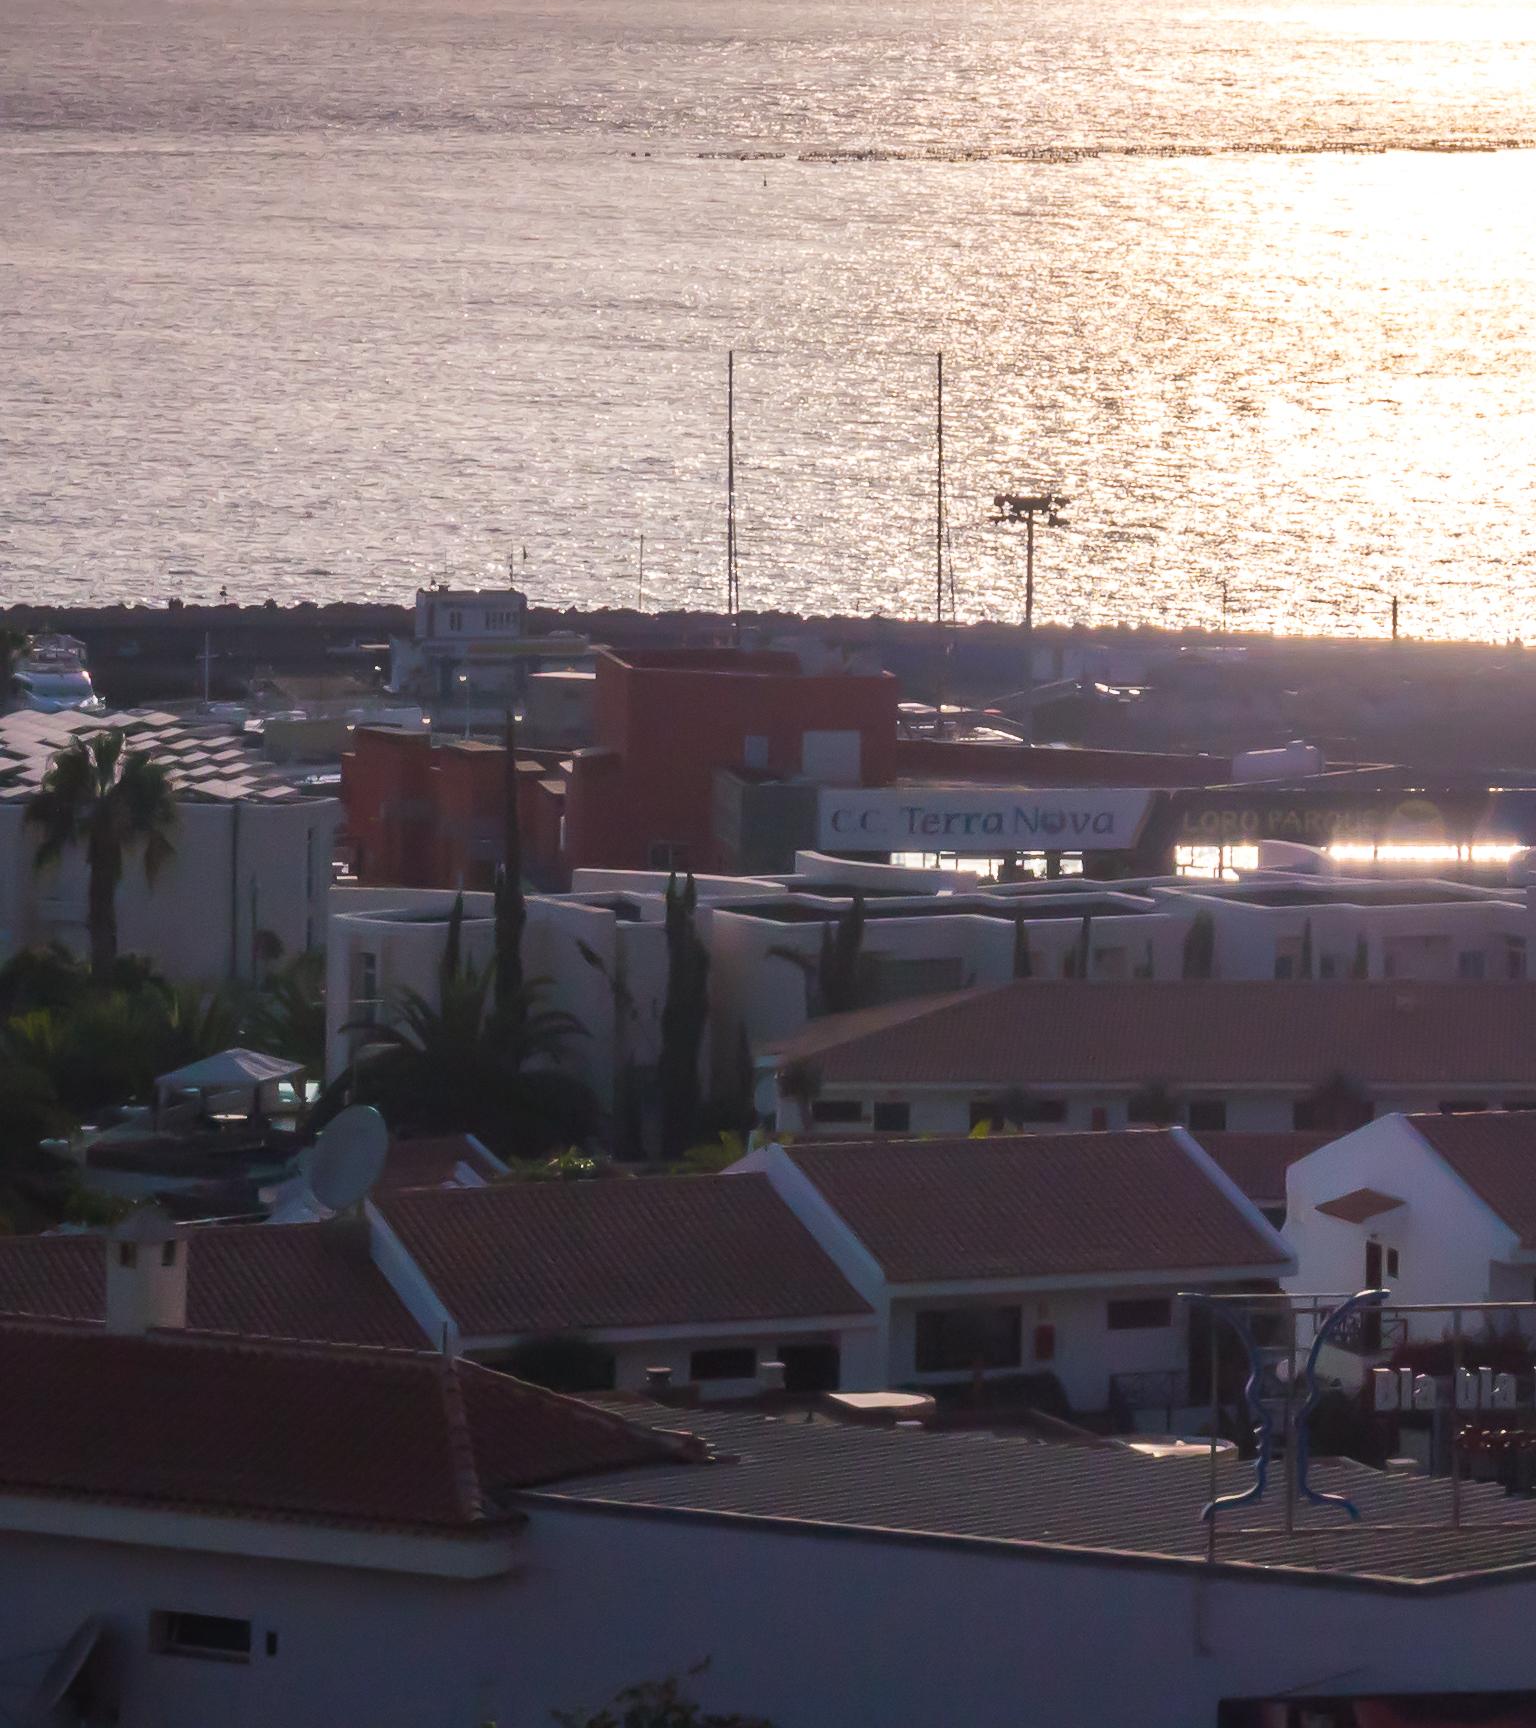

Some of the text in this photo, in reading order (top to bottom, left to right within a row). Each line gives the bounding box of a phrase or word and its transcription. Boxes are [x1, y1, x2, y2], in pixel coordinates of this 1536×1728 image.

[831, 807, 1115, 835] C.C. Terra Nova
[1182, 810, 1259, 835] LORO
[1373, 1366, 1436, 1410] Bla
[1455, 1366, 1517, 1409] bla
